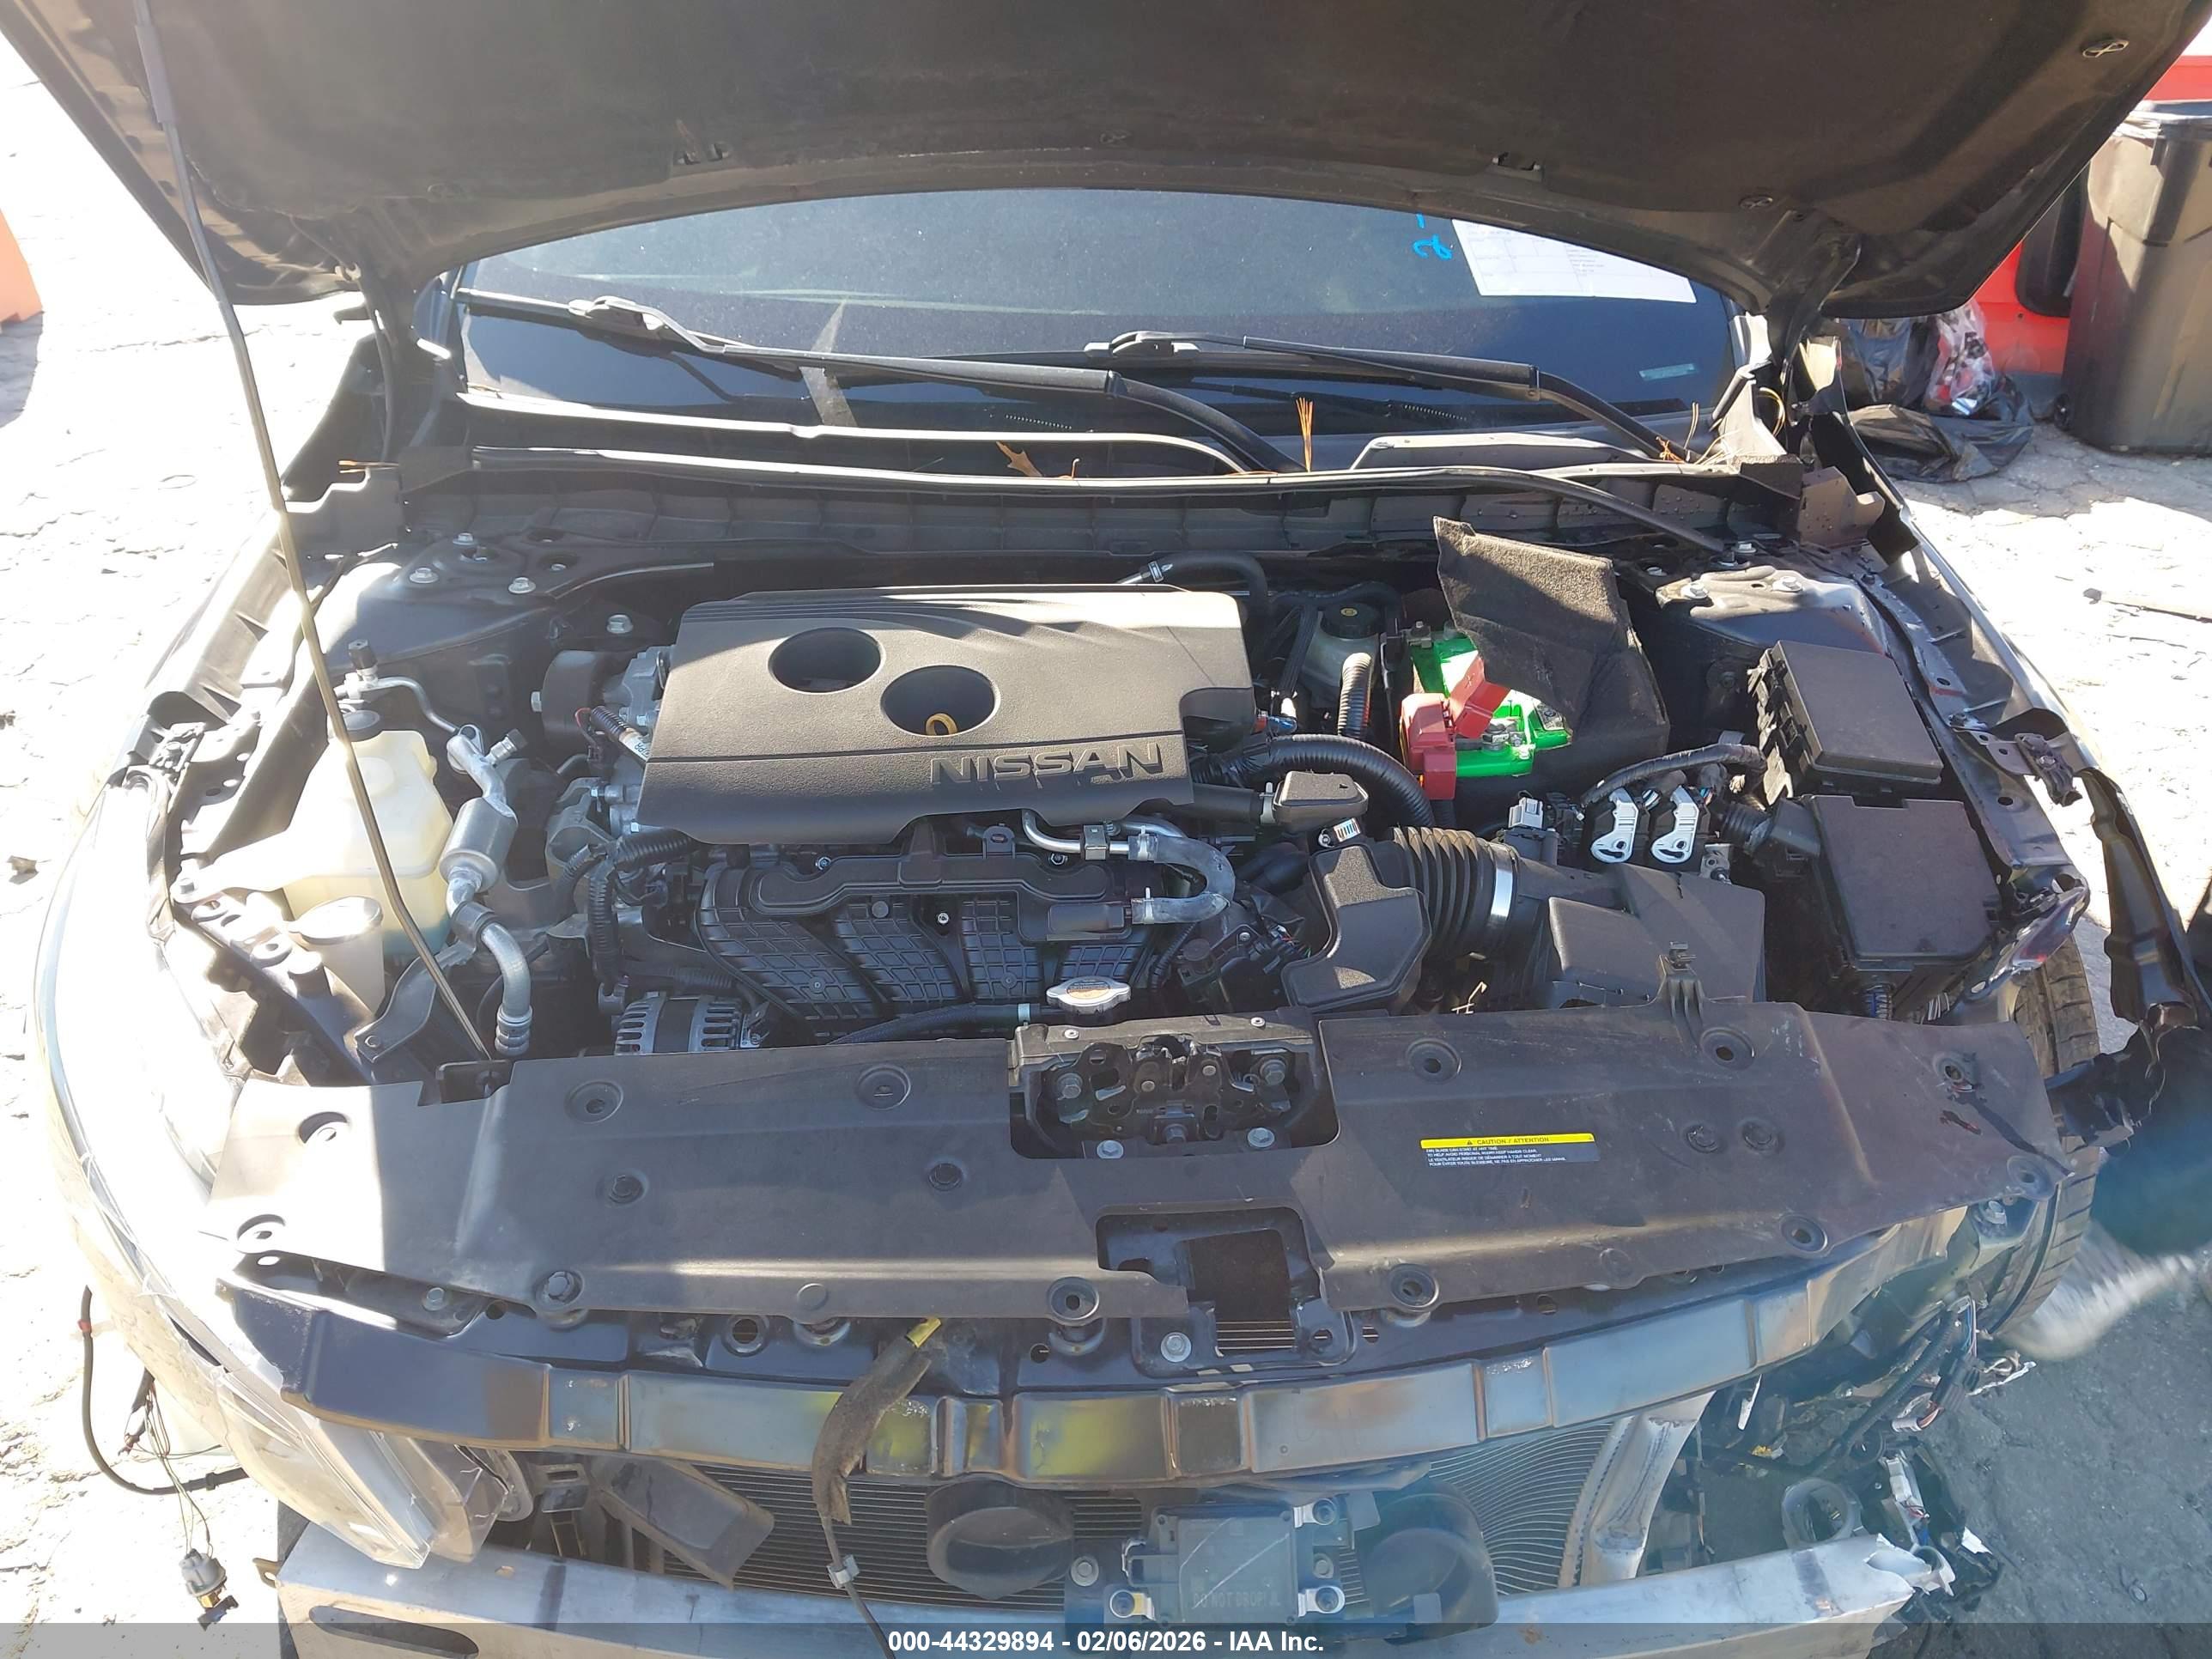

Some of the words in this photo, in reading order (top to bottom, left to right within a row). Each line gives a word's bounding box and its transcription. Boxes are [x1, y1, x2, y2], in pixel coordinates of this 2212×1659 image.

[931, 743, 1160, 783] NISSAN
[1193, 1592, 1207, 1607] DO
[1211, 1591, 1233, 1607] NOT
